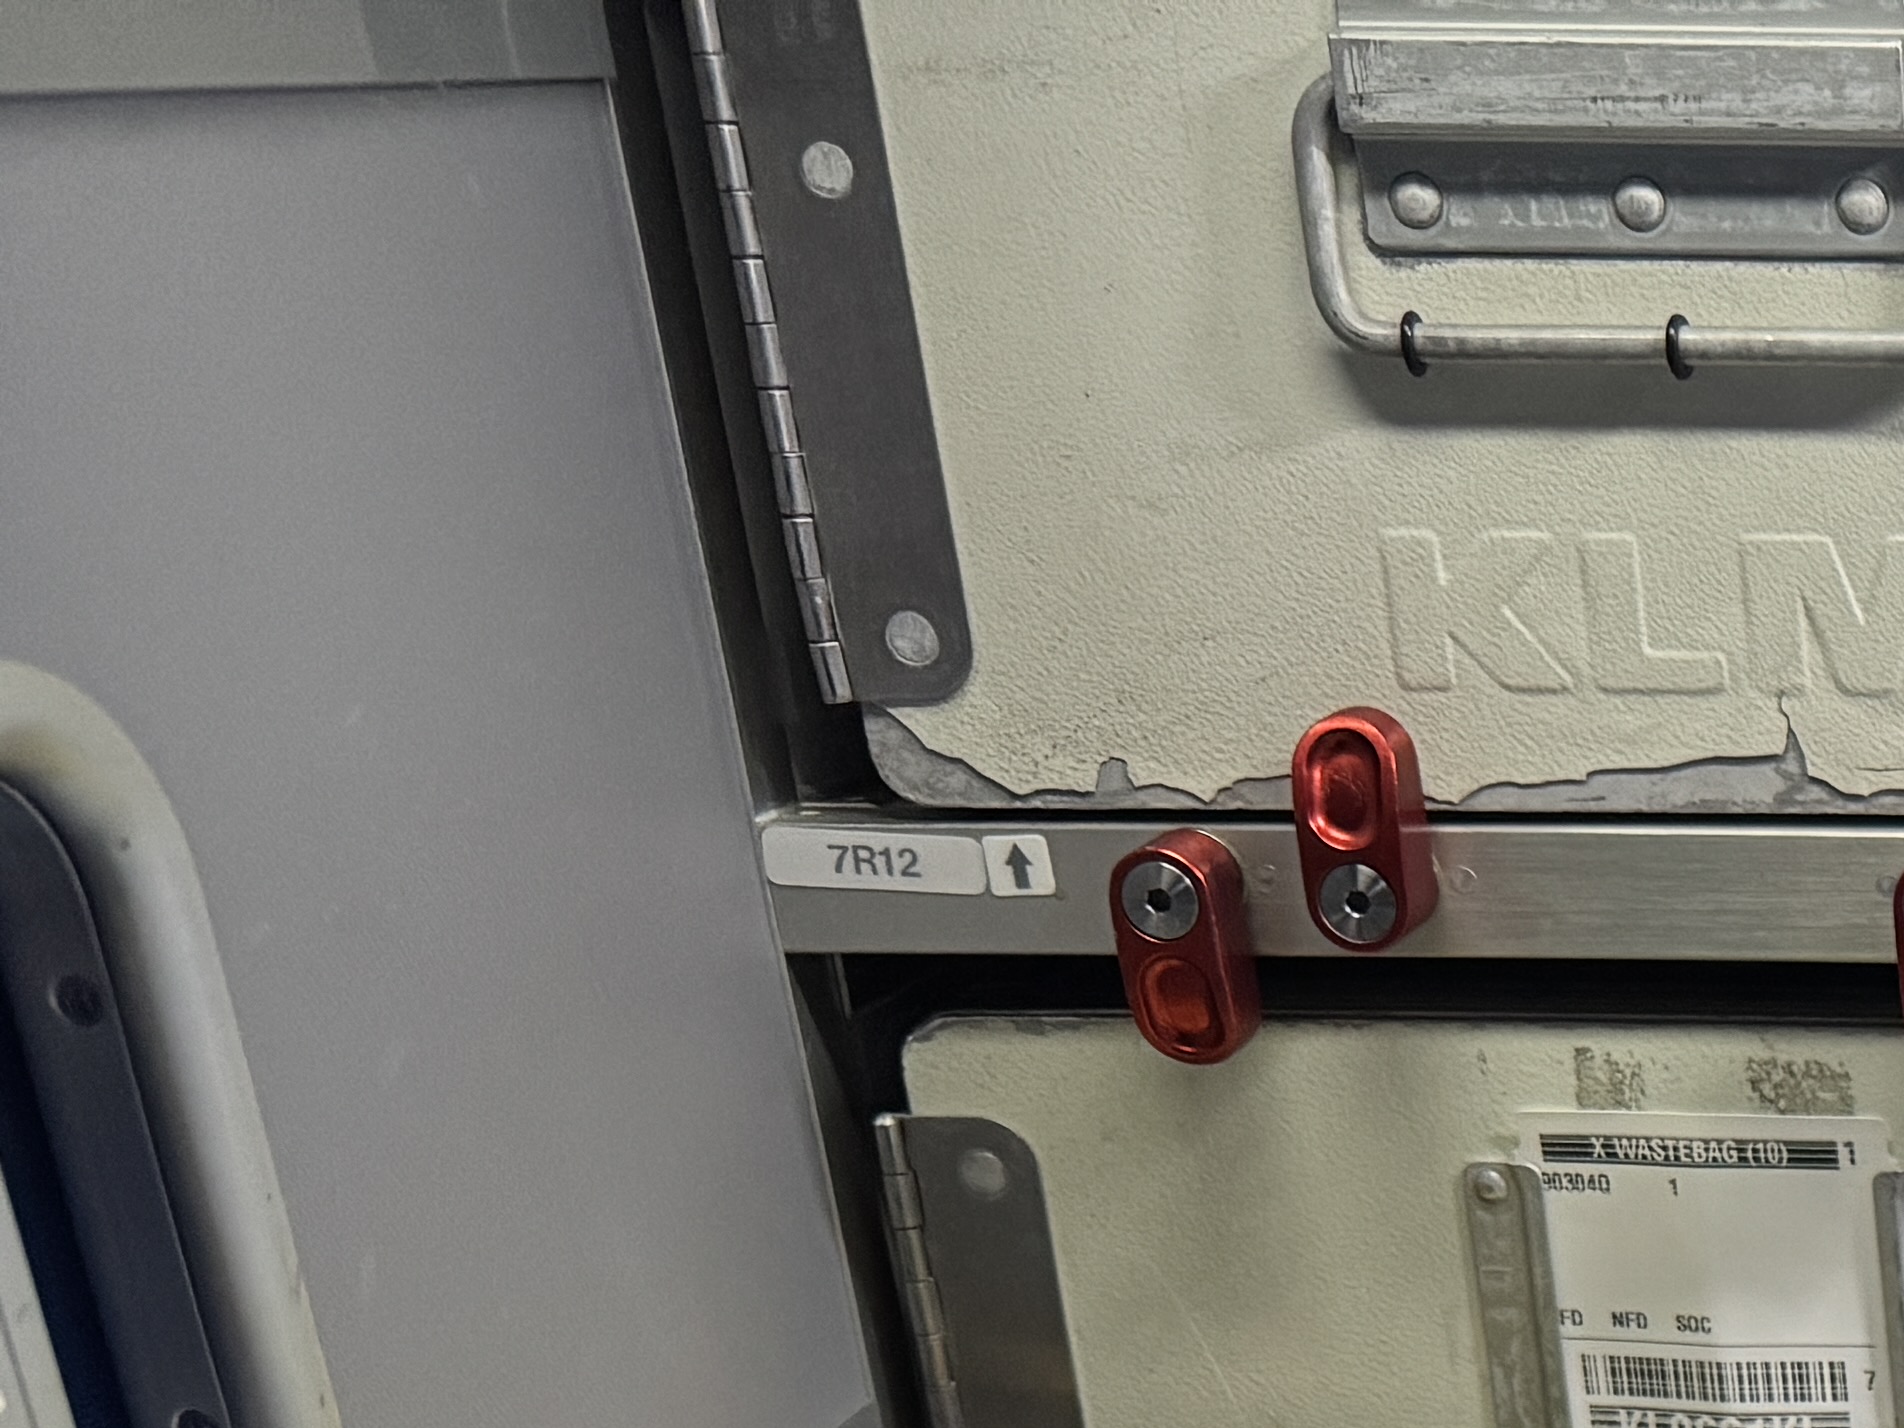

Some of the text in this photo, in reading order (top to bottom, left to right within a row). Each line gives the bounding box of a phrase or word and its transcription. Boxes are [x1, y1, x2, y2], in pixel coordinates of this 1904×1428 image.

[825, 842, 922, 881] 7R12
[1612, 1138, 1738, 1165] WASTEBAG
[1747, 1142, 1790, 1168] (10)
[1844, 1141, 1857, 1166] 1
[1668, 1177, 1679, 1197] 1
[1611, 1311, 1649, 1331] NFD
[1863, 1370, 1876, 1391] 7
